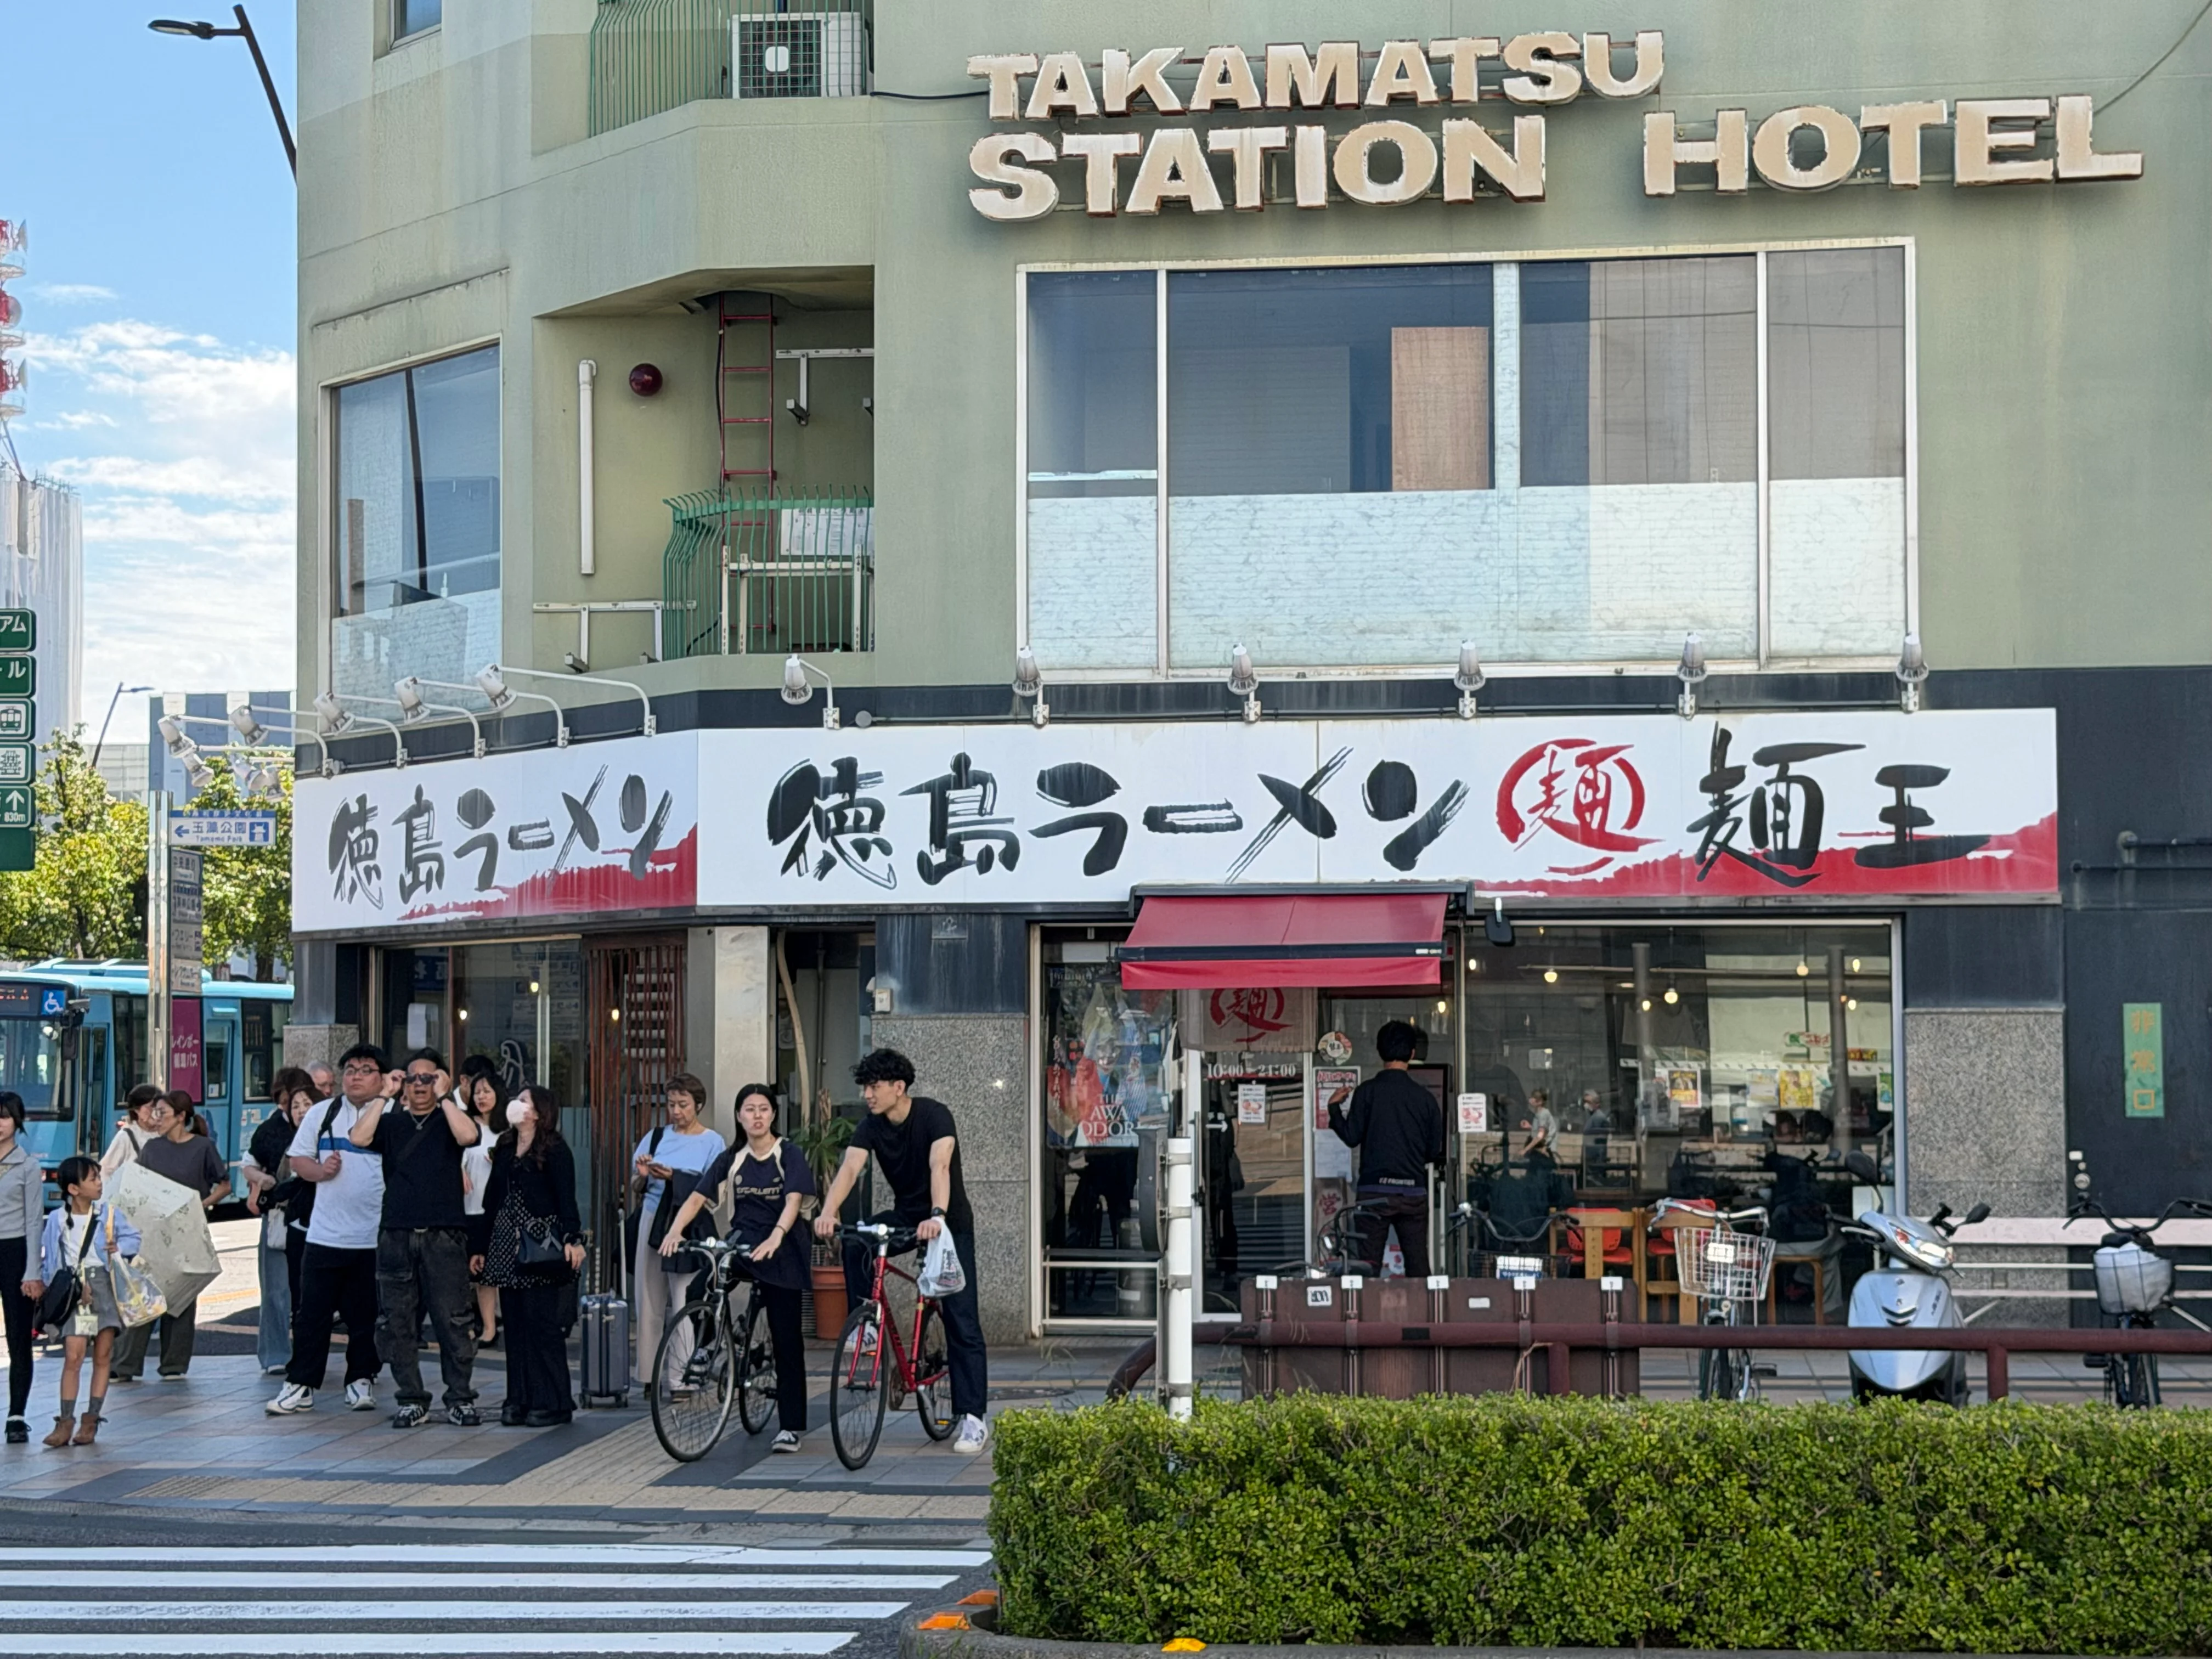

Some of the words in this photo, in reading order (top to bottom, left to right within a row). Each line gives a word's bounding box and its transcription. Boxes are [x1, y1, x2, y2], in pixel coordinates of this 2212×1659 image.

[967, 31, 1666, 120] TAKAMATSU
[968, 114, 1547, 222] STATION
[1644, 94, 2143, 196] HOTEL
[193, 821, 246, 834] 玉藻公園
[329, 764, 673, 910] 徳島ラーメン
[767, 745, 1471, 890] 徳島ラーメン
[1090, 1104, 1129, 1121] AWA
